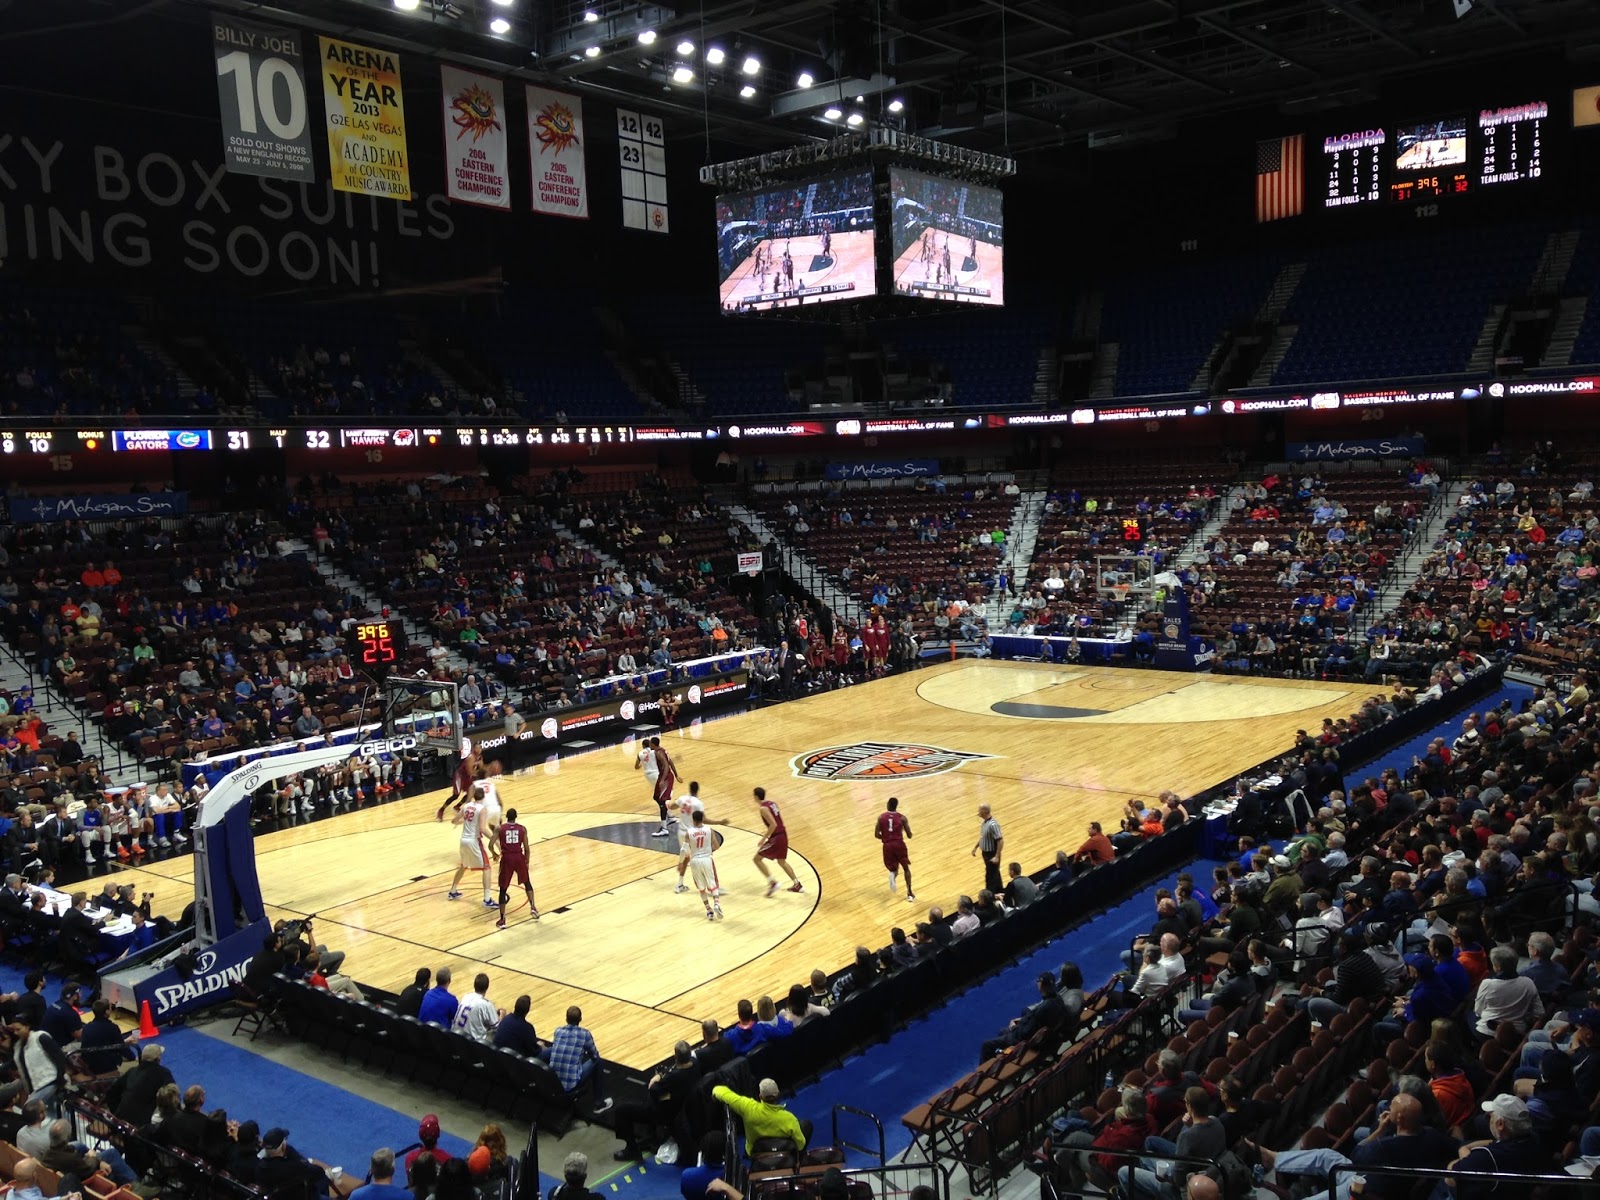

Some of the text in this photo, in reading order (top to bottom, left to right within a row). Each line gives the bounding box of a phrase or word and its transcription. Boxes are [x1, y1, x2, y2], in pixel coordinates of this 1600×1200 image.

[215, 25, 300, 56] BILLY JOEL
[326, 44, 396, 74] ARENA
[346, 66, 379, 81] OF THE
[217, 51, 306, 140] 10
[330, 74, 398, 108] YEAR
[353, 102, 380, 116] 2013
[330, 114, 402, 136] G2E LAS VEGAS
[621, 116, 662, 138] 12 42
[1484, 127, 1496, 136] 00
[362, 134, 376, 142] AND
[1326, 128, 1384, 145] FLORIDA
[230, 136, 306, 155] SOLD OUT SHOWS
[1485, 146, 1496, 154] 15
[227, 145, 310, 164] A NEW ENGLAND RECORD
[344, 142, 404, 168] ACADEMY
[469, 149, 486, 160] 2004
[623, 146, 640, 163] 23
[1484, 156, 1495, 164] 24
[236, 154, 250, 164] MAY
[266, 158, 281, 168] JULY
[290, 163, 304, 171] 2008
[462, 158, 494, 174] EASTERN
[550, 162, 567, 173] 2005
[1484, 165, 1495, 174] 25
[1530, 158, 1540, 167] 14
[94, 145, 231, 213] BOX
[350, 164, 402, 181] of COUNTRY
[456, 168, 503, 186] CONFERENCE
[544, 172, 574, 185] EASTERN
[1480, 167, 1541, 184] TEAM FOULS 10
[344, 176, 408, 195] MUSIC AWARDS
[458, 180, 502, 197] CHAMPIONS
[538, 182, 580, 197] CONFERENCE
[1329, 180, 1339, 188] 24
[1456, 181, 1468, 192] 32
[541, 193, 579, 207] CHAMPIONS
[1326, 191, 1379, 206] TEAM FOULS 10
[183, 220, 380, 288] SOON!
[1510, 382, 1593, 394] HOOPHALL.COM
[1344, 396, 1394, 405] BASKETBALL
[1430, 392, 1454, 400] FAME
[1362, 408, 1384, 420] 20
[2, 431, 282, 454] 9 10 GATORS 31 1
[124, 430, 170, 440] FLORIDA
[306, 430, 386, 448] 32 HAWKS
[459, 434, 472, 444] 10
[365, 450, 382, 462] 16
[1316, 442, 1408, 456] Mohegan Sun
[50, 454, 74, 471] 15
[852, 464, 928, 476] Mohegan Sun
[56, 496, 172, 516] Mohegan Sun
[1124, 526, 1140, 540] 25
[740, 556, 760, 566] ESPN
[1164, 616, 1182, 624] ZALES
[363, 638, 394, 662] 25
[360, 738, 416, 757] GEICO
[231, 762, 262, 784] SPALDING
[464, 810, 475, 822] 32
[888, 818, 894, 832] 1
[506, 830, 519, 844] 25
[696, 836, 704, 848] 11
